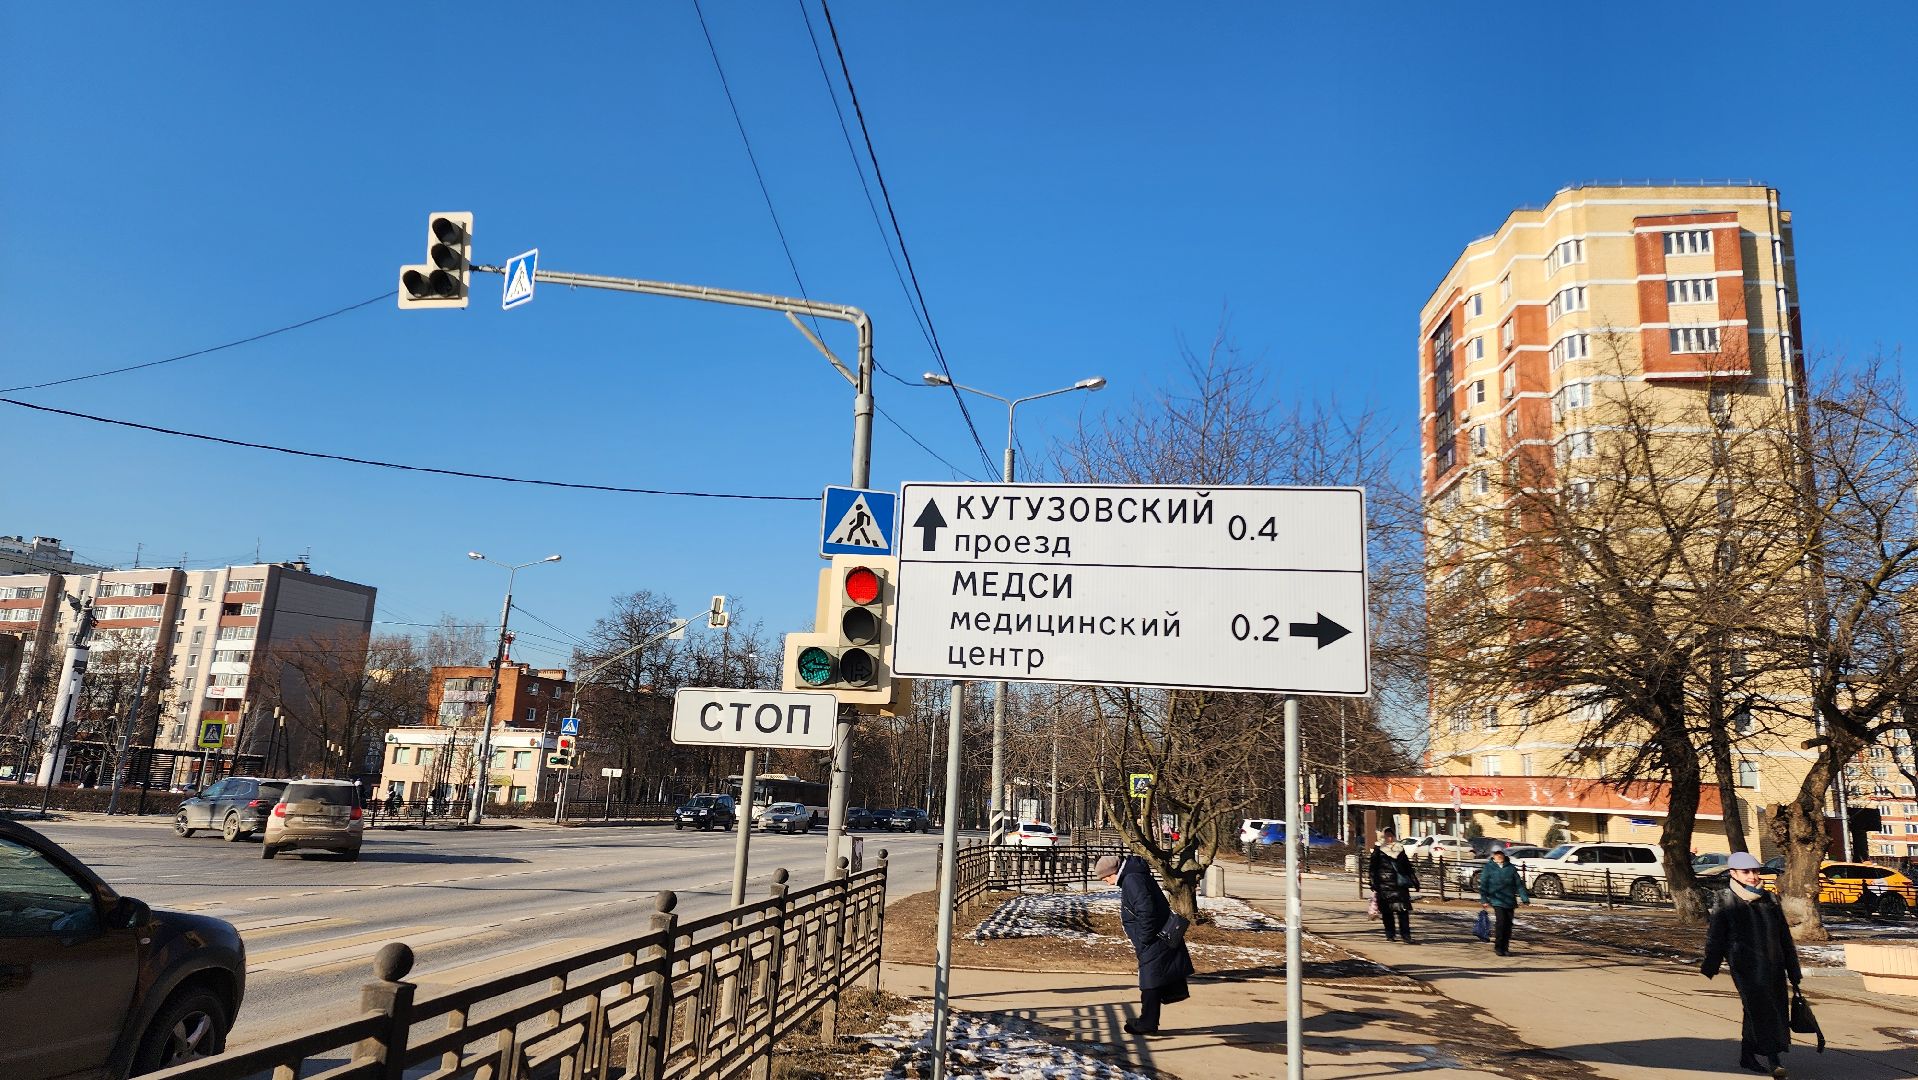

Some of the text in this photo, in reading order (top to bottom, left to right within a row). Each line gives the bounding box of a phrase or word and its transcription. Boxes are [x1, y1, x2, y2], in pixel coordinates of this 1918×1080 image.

[956, 491, 1213, 525] КУТУЗОВСКИЙ
[1228, 514, 1279, 542] 0.4
[955, 534, 1071, 560] проезд
[953, 570, 1073, 602] МЕДСИ
[950, 610, 1180, 638] медицинский
[1231, 613, 1280, 642] 0.2
[948, 645, 1045, 675] центр
[700, 701, 811, 735] СТОП
